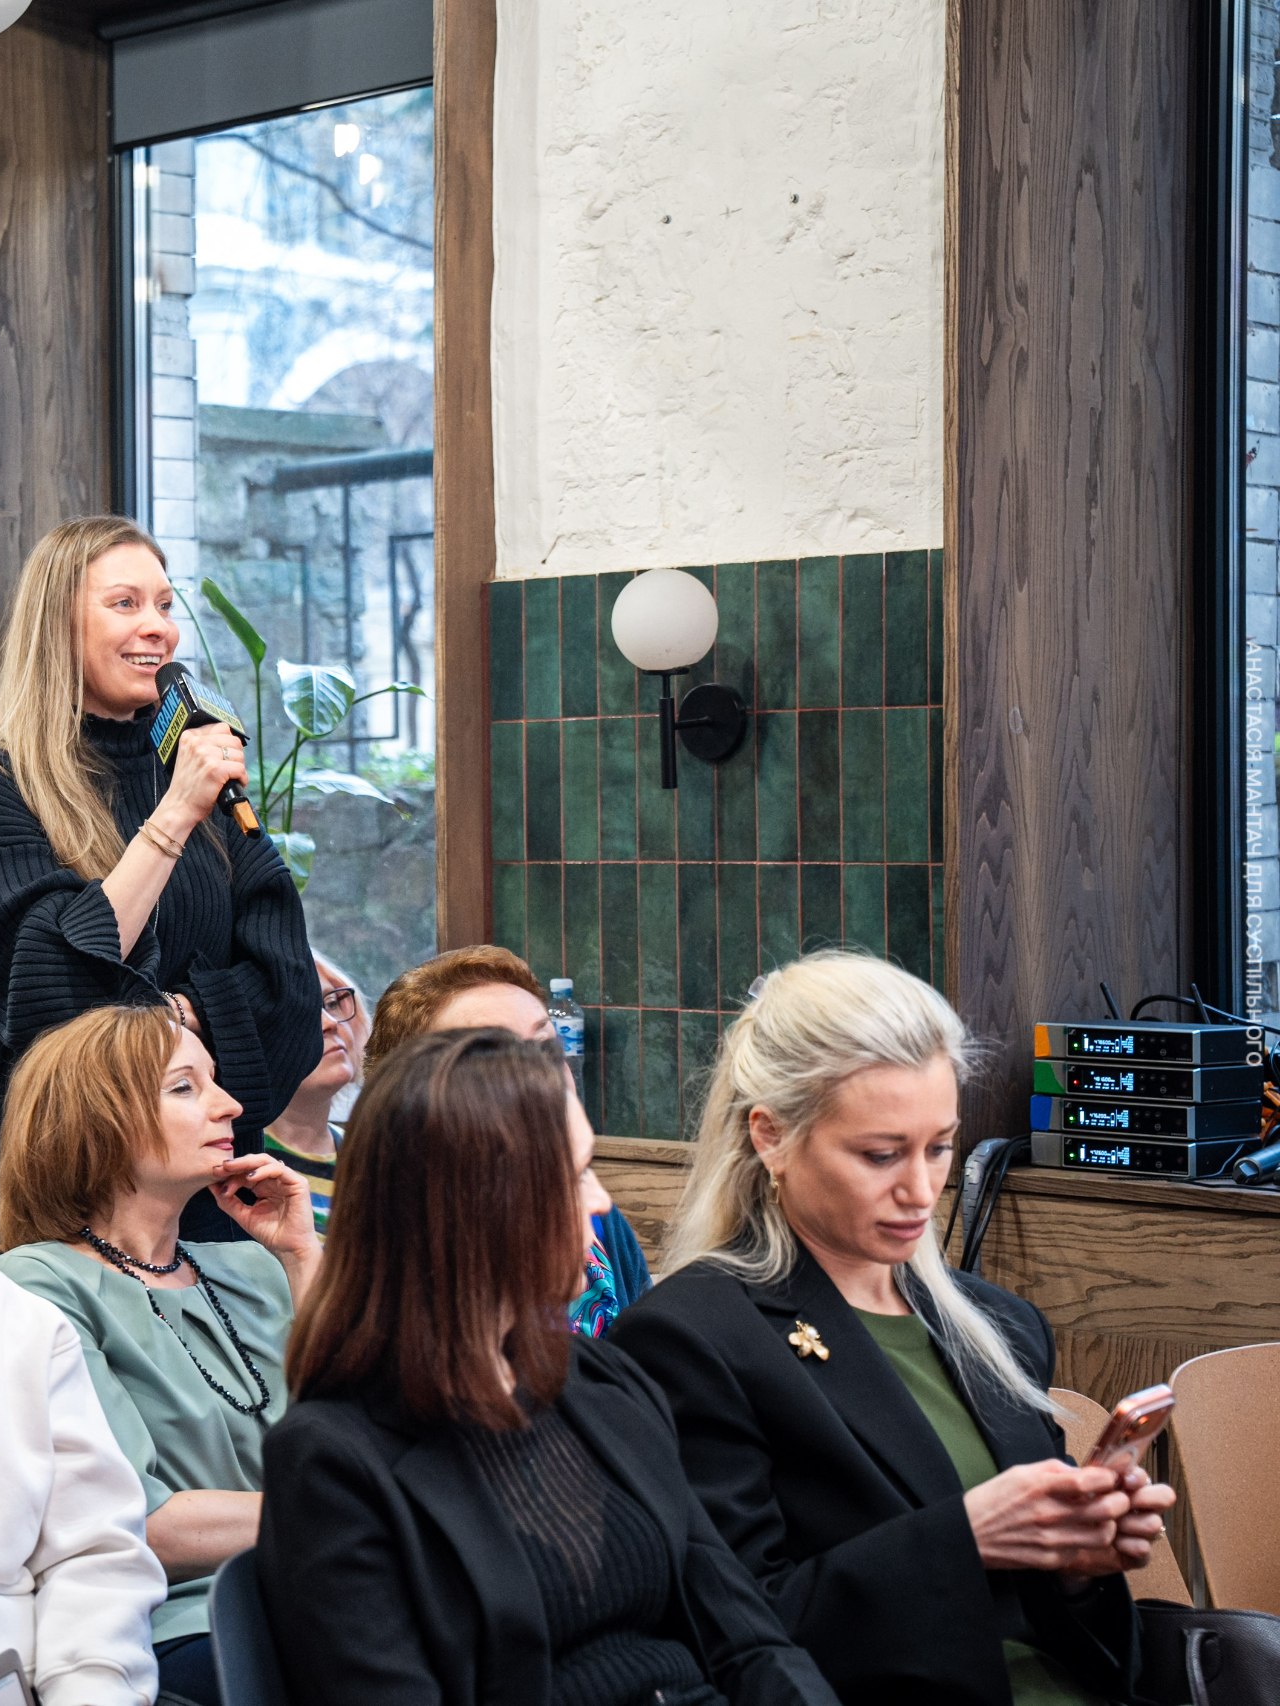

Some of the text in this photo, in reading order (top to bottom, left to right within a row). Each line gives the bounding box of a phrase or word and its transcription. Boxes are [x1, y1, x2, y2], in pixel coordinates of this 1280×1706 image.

[150, 684, 181, 748] UKRAINE
[159, 706, 186, 758] MEDIA CENTER
